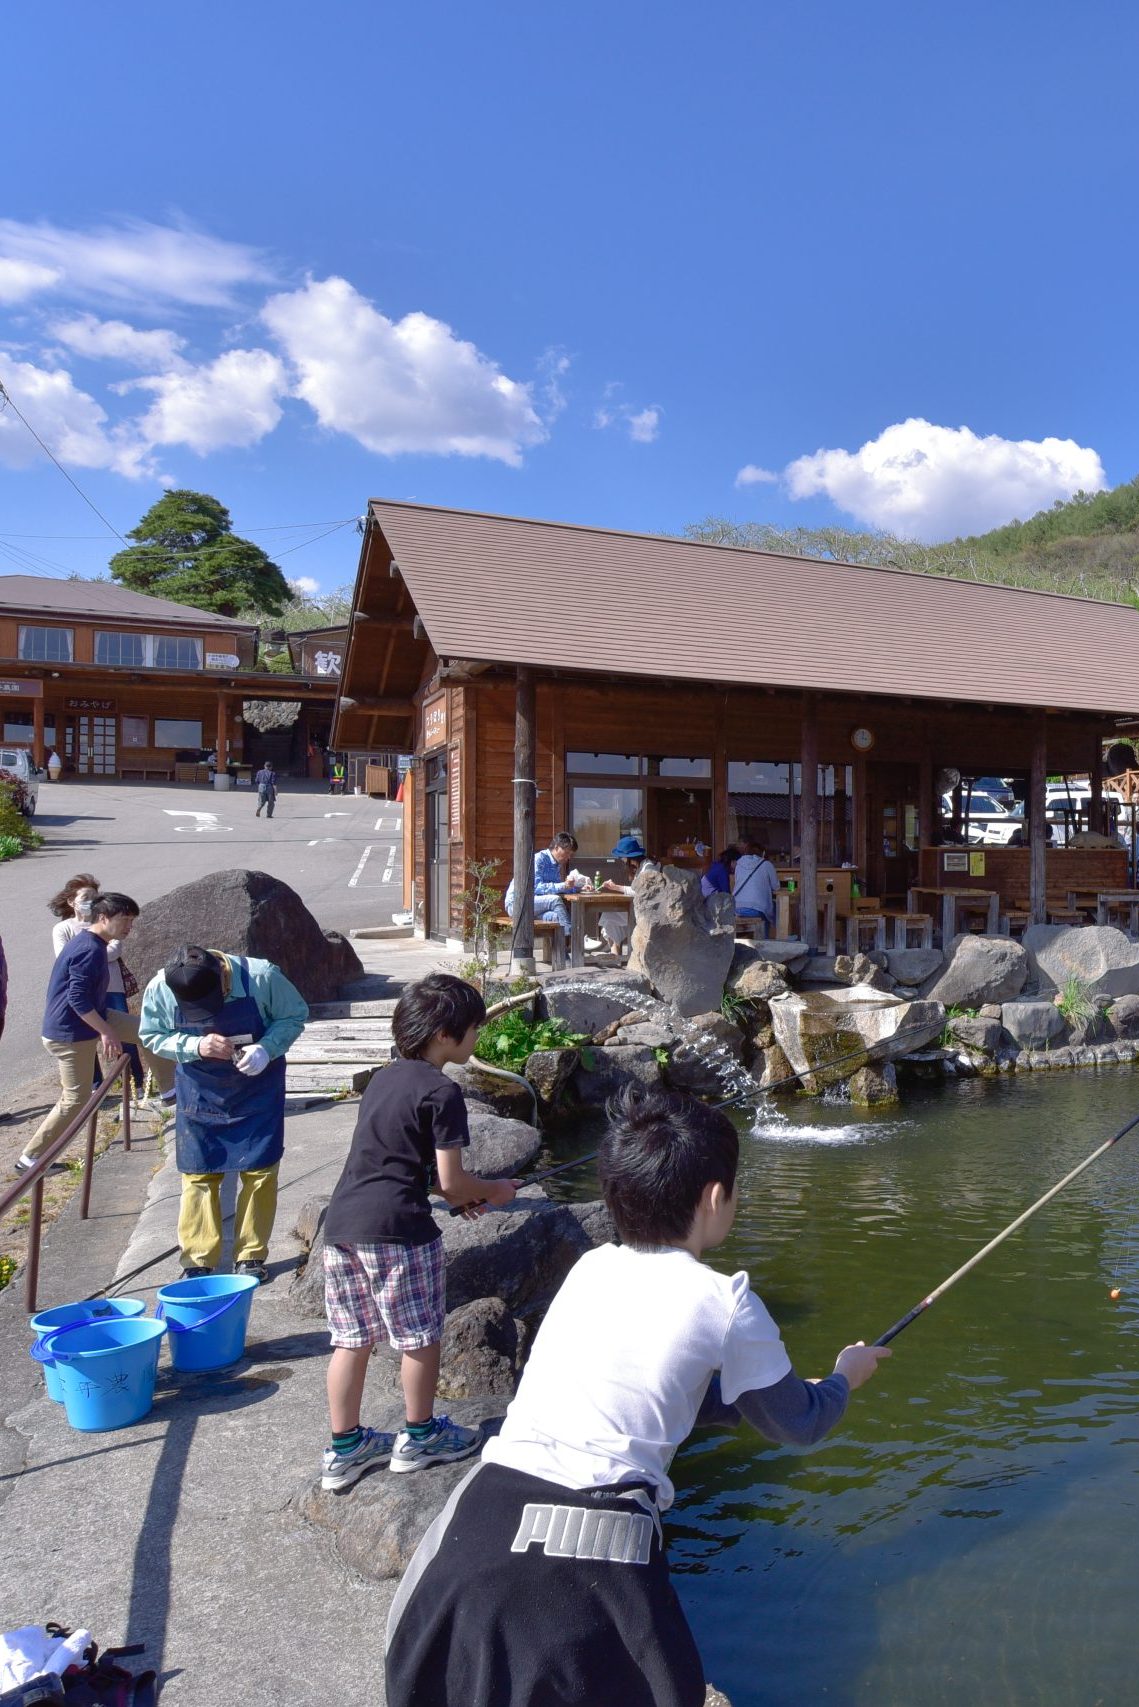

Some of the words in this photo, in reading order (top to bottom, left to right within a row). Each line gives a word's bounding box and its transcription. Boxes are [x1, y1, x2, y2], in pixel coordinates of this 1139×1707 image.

[69, 699, 112, 710] おみやげ
[510, 1503, 654, 1565] PUMA
